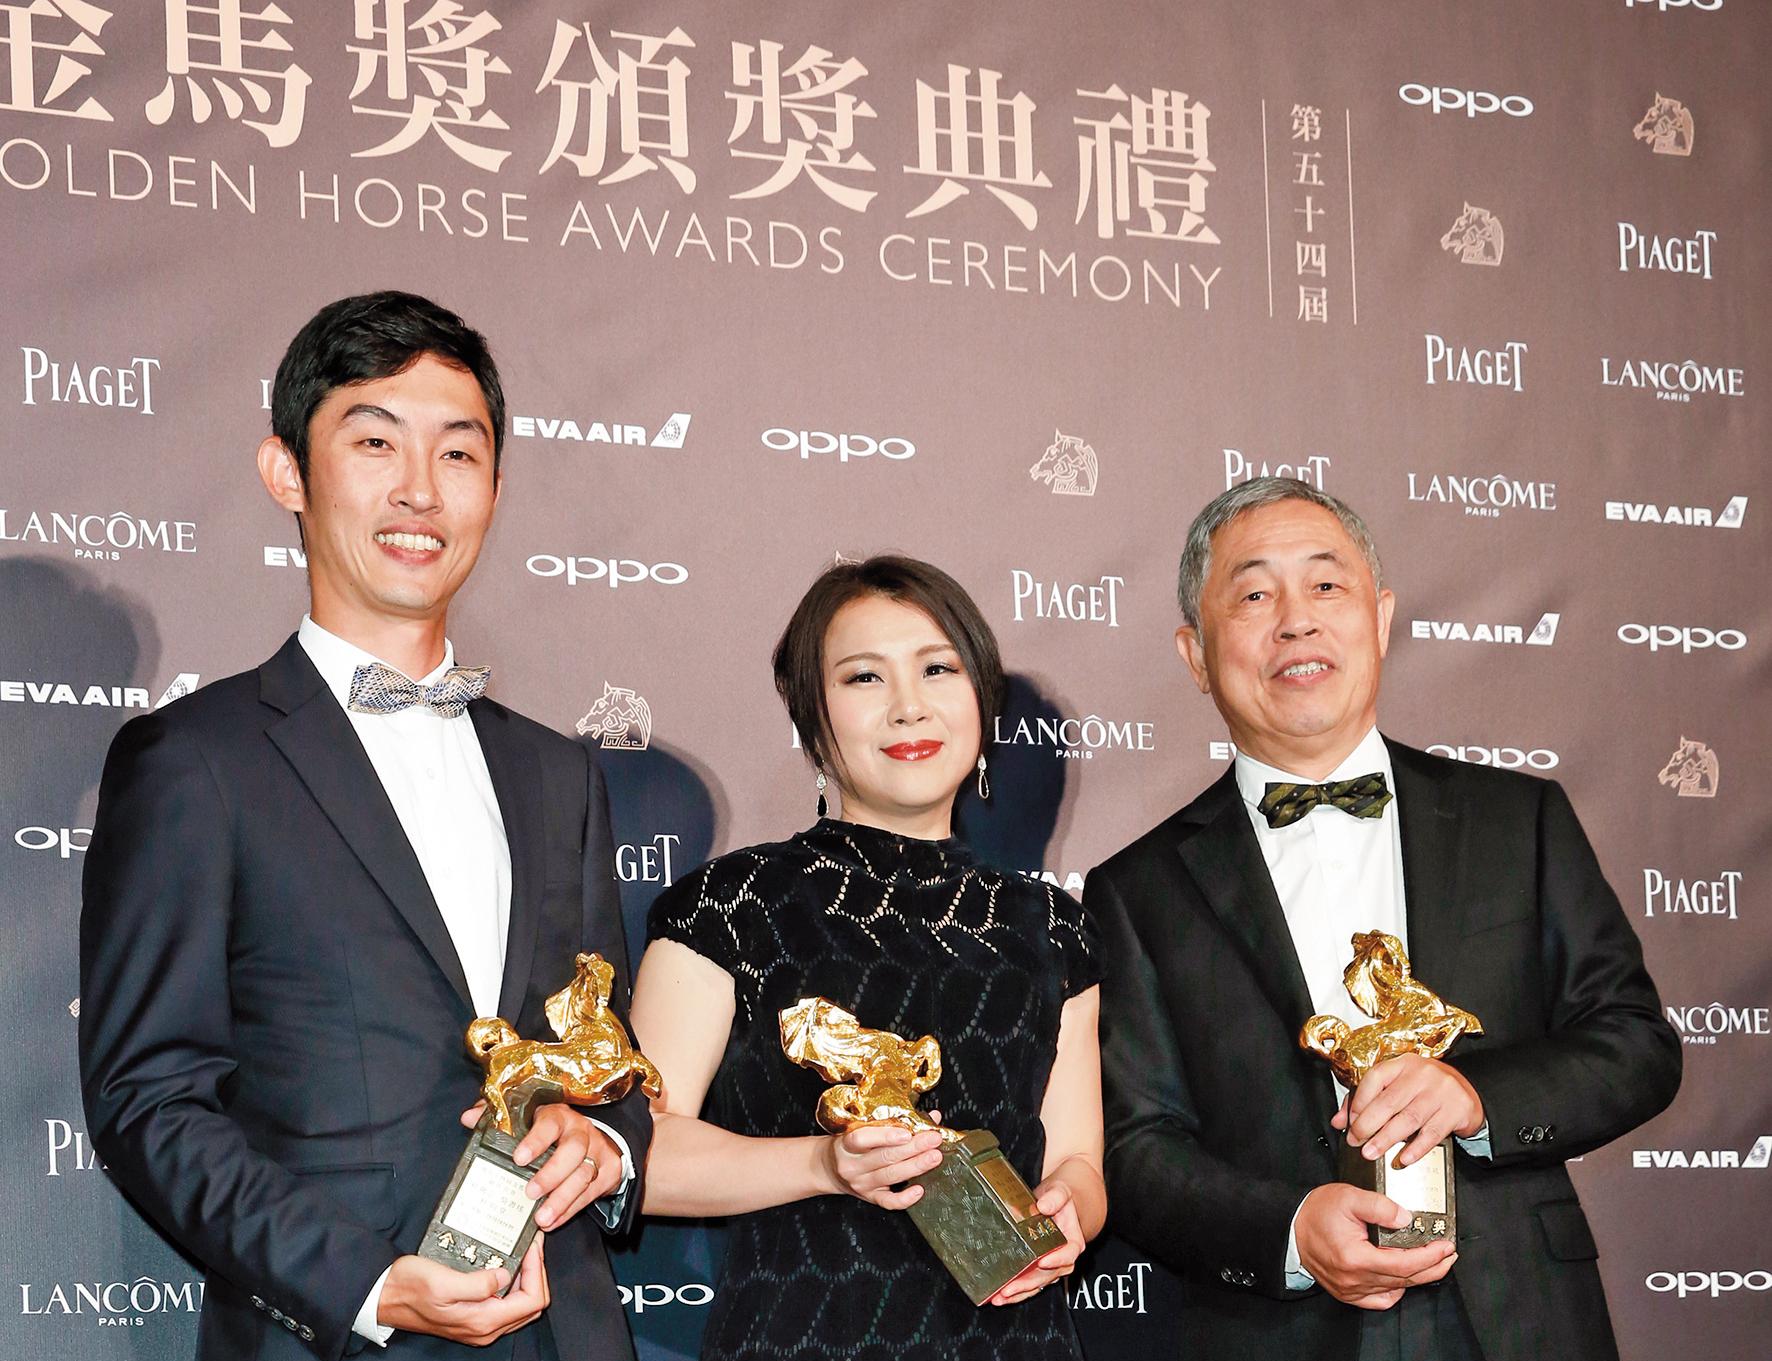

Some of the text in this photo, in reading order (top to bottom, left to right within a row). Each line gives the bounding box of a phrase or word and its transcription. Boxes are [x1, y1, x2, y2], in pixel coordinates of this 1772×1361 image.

[0, 138, 1221, 310] OLDEN HORSE AWARDS CEREMONY
[1291, 103, 1328, 324] 第五十四屆
[1618, 222, 1717, 280] PIAGET
[21, 347, 161, 415] PIAGET
[1425, 334, 1528, 392] PIAGET
[1601, 359, 1744, 394] LANCÔME
[1656, 391, 1691, 400] PARIS
[1407, 473, 1556, 510] LANCÔME
[1465, 507, 1500, 516] PARIS
[0, 510, 196, 553] LANCÔME
[75, 549, 121, 560] PARIS
[1011, 569, 1125, 627] PIAGET
[993, 714, 1155, 750] LANCÔME
[1056, 750, 1093, 759] PARIS
[615, 835, 680, 887] GET
[1643, 868, 1742, 920] PIAGET
[1666, 1002, 1770, 1034] NCÔME
[1683, 1036, 1717, 1044] PARIS
[1067, 1263, 1152, 1314] AGET
[99, 1317, 144, 1326] PARIS
